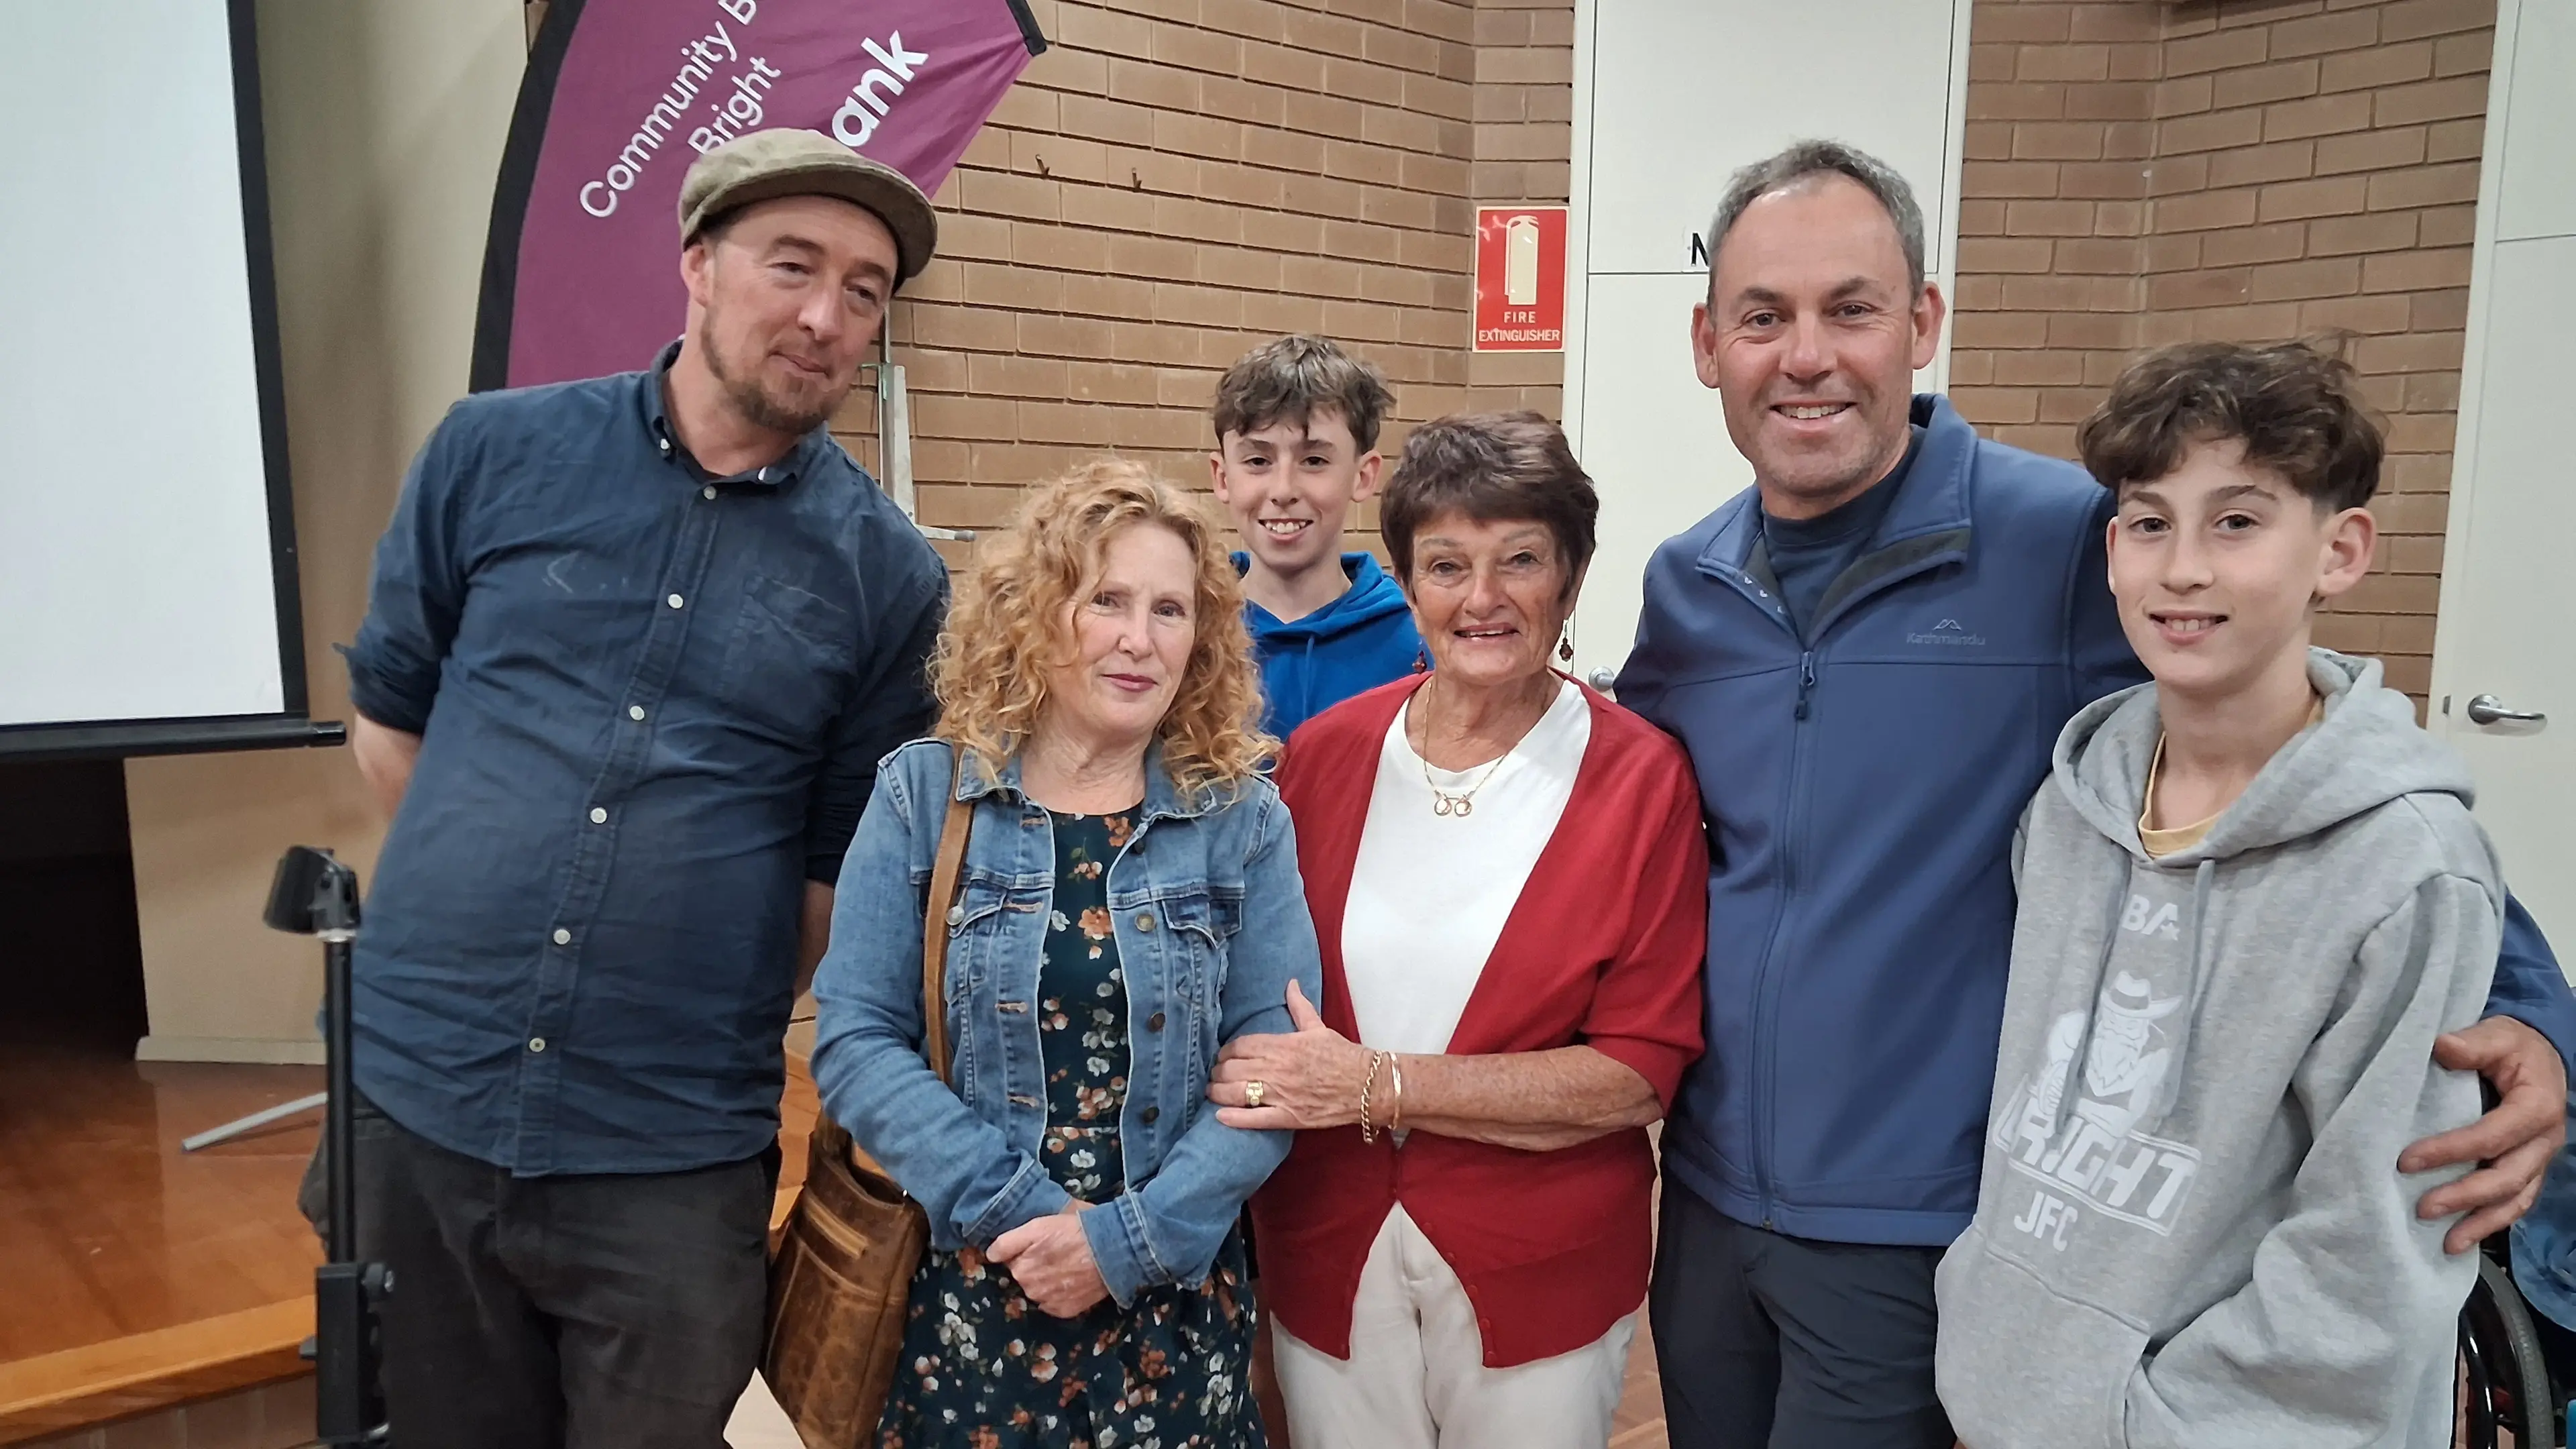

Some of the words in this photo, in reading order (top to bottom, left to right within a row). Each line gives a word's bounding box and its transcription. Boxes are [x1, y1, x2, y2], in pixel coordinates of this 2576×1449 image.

[580, 20, 737, 217] Community
[687, 56, 782, 155] Bright
[832, 30, 929, 147] ank
[1479, 328, 1560, 342] EXTINGUISHER
[1503, 311, 1536, 323] FIRE
[2001, 1097, 2196, 1220] RIGHT
[2014, 1191, 2078, 1252] JFC
